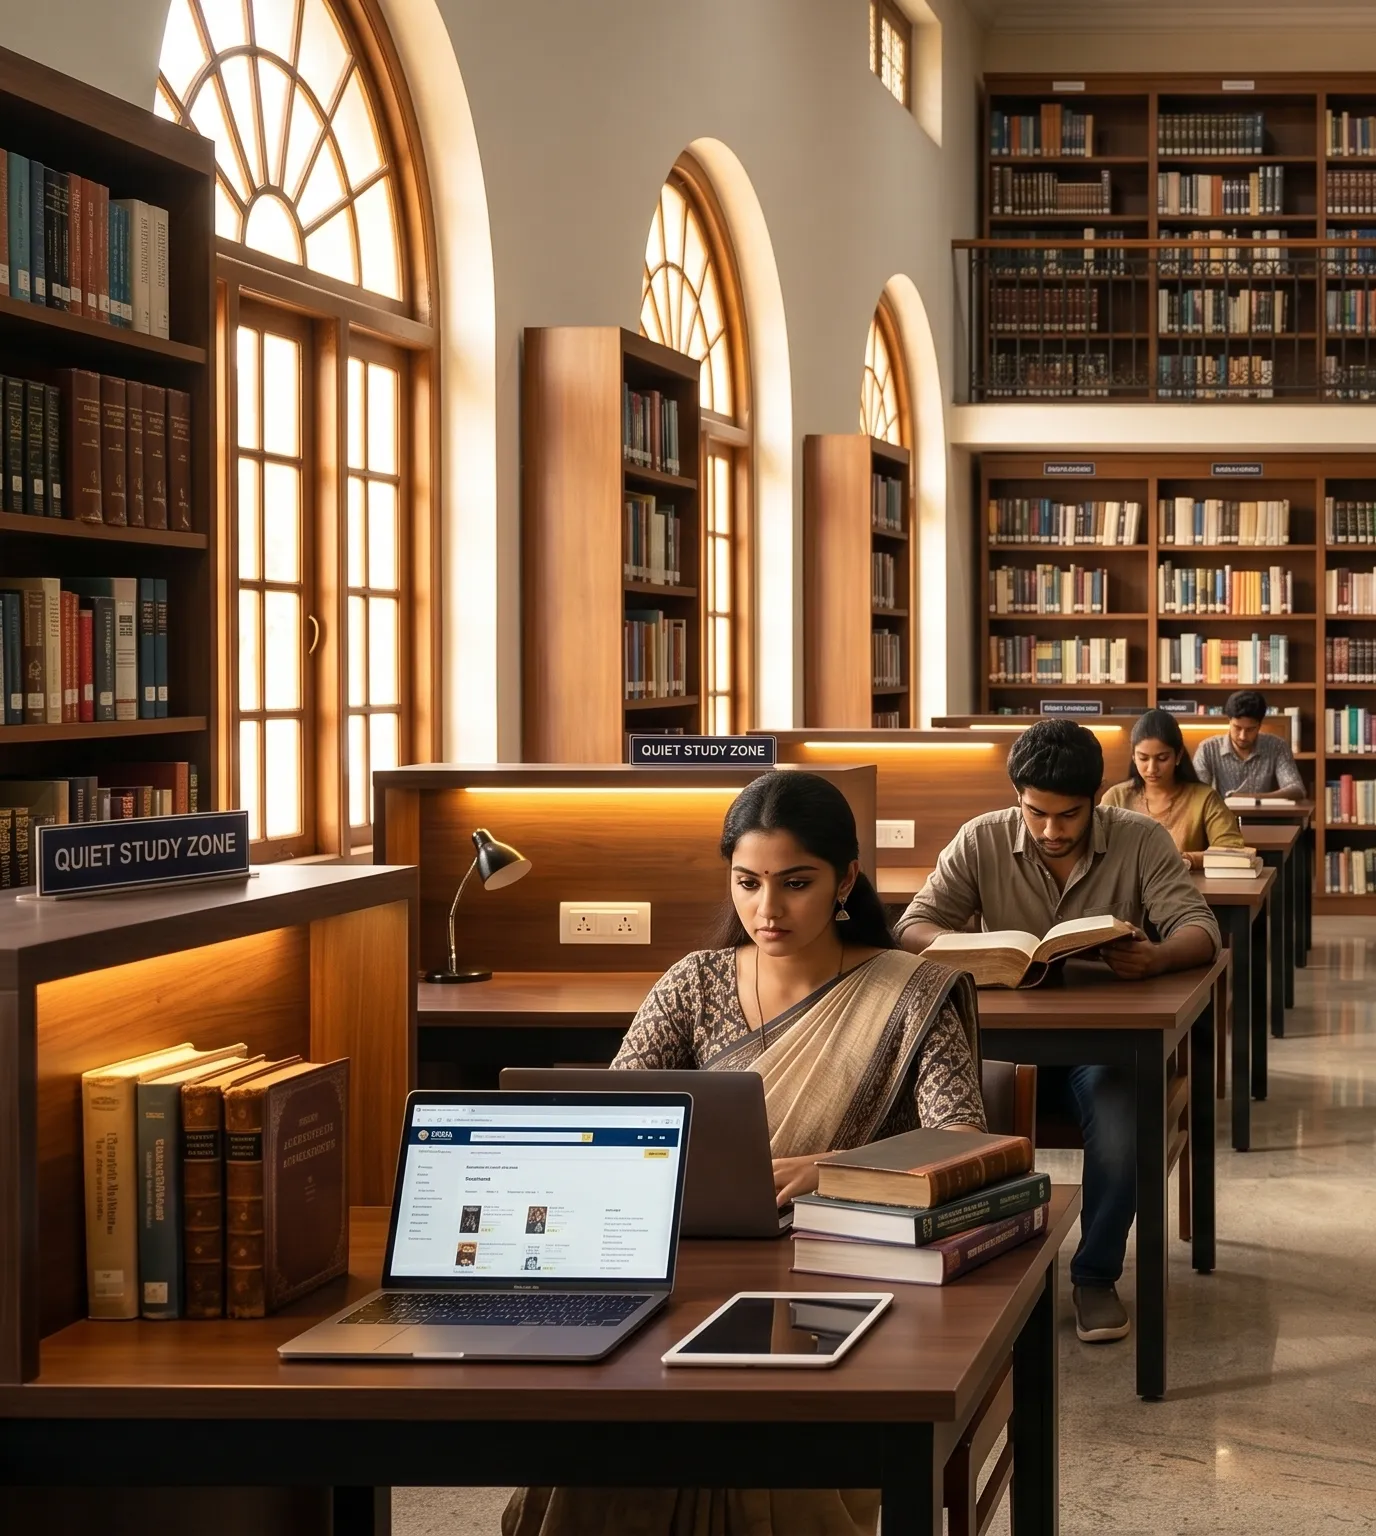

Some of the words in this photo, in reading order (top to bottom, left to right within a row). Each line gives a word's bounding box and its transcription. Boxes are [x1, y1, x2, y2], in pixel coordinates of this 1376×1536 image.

[641, 745, 681, 756] QUIET
[684, 745, 727, 756] STUDY
[730, 745, 765, 756] ZONE
[55, 844, 115, 871] QUIET
[120, 837, 183, 864] STUDY
[187, 832, 236, 857] ZONE
